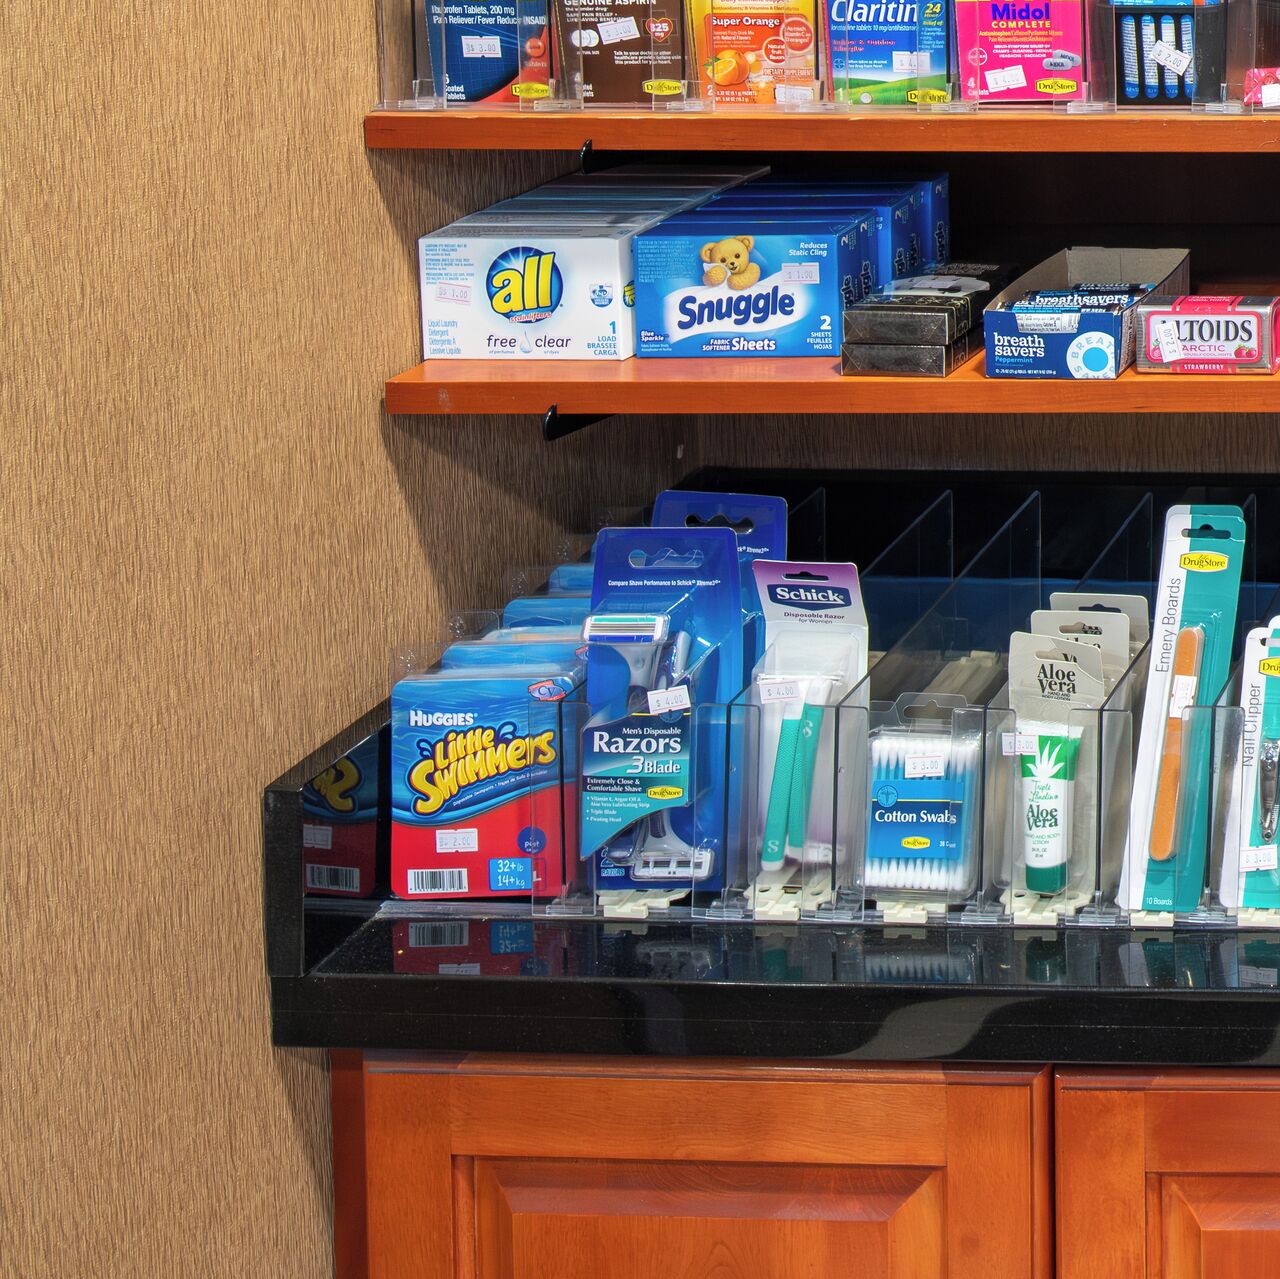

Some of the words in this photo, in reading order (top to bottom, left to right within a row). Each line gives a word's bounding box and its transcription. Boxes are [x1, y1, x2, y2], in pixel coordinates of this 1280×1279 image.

[465, 5, 489, 15] Tablets,
[504, 7, 514, 15] mg
[925, 4, 941, 13] 24
[991, 3, 1049, 20] Midol
[992, 21, 1050, 29] COMPLETE
[678, 286, 794, 330] Snuggle
[820, 316, 831, 329] 2
[487, 335, 516, 348] free
[535, 336, 571, 347] clear
[732, 338, 775, 350] Sheets
[994, 333, 1044, 347] breath
[995, 345, 1044, 356] savers
[1182, 344, 1225, 352] ARCTIC
[776, 587, 840, 602] Schick
[1160, 578, 1181, 626] Boards
[1155, 629, 1172, 673] Emery
[1038, 664, 1075, 682] Aloe
[777, 687, 794, 696] 4.00
[665, 695, 683, 706] 4.00
[410, 710, 474, 726] HUGGIES
[643, 728, 681, 736] Disposable
[593, 733, 681, 753] Razors
[627, 756, 642, 773] 3
[644, 762, 680, 773] Blade
[920, 761, 938, 770] 3.00
[1027, 804, 1058, 817] Aloe
[875, 811, 916, 822] Cotton
[920, 811, 956, 824] Swabs
[497, 874, 515, 886] 14+
[516, 878, 525, 888] kg
